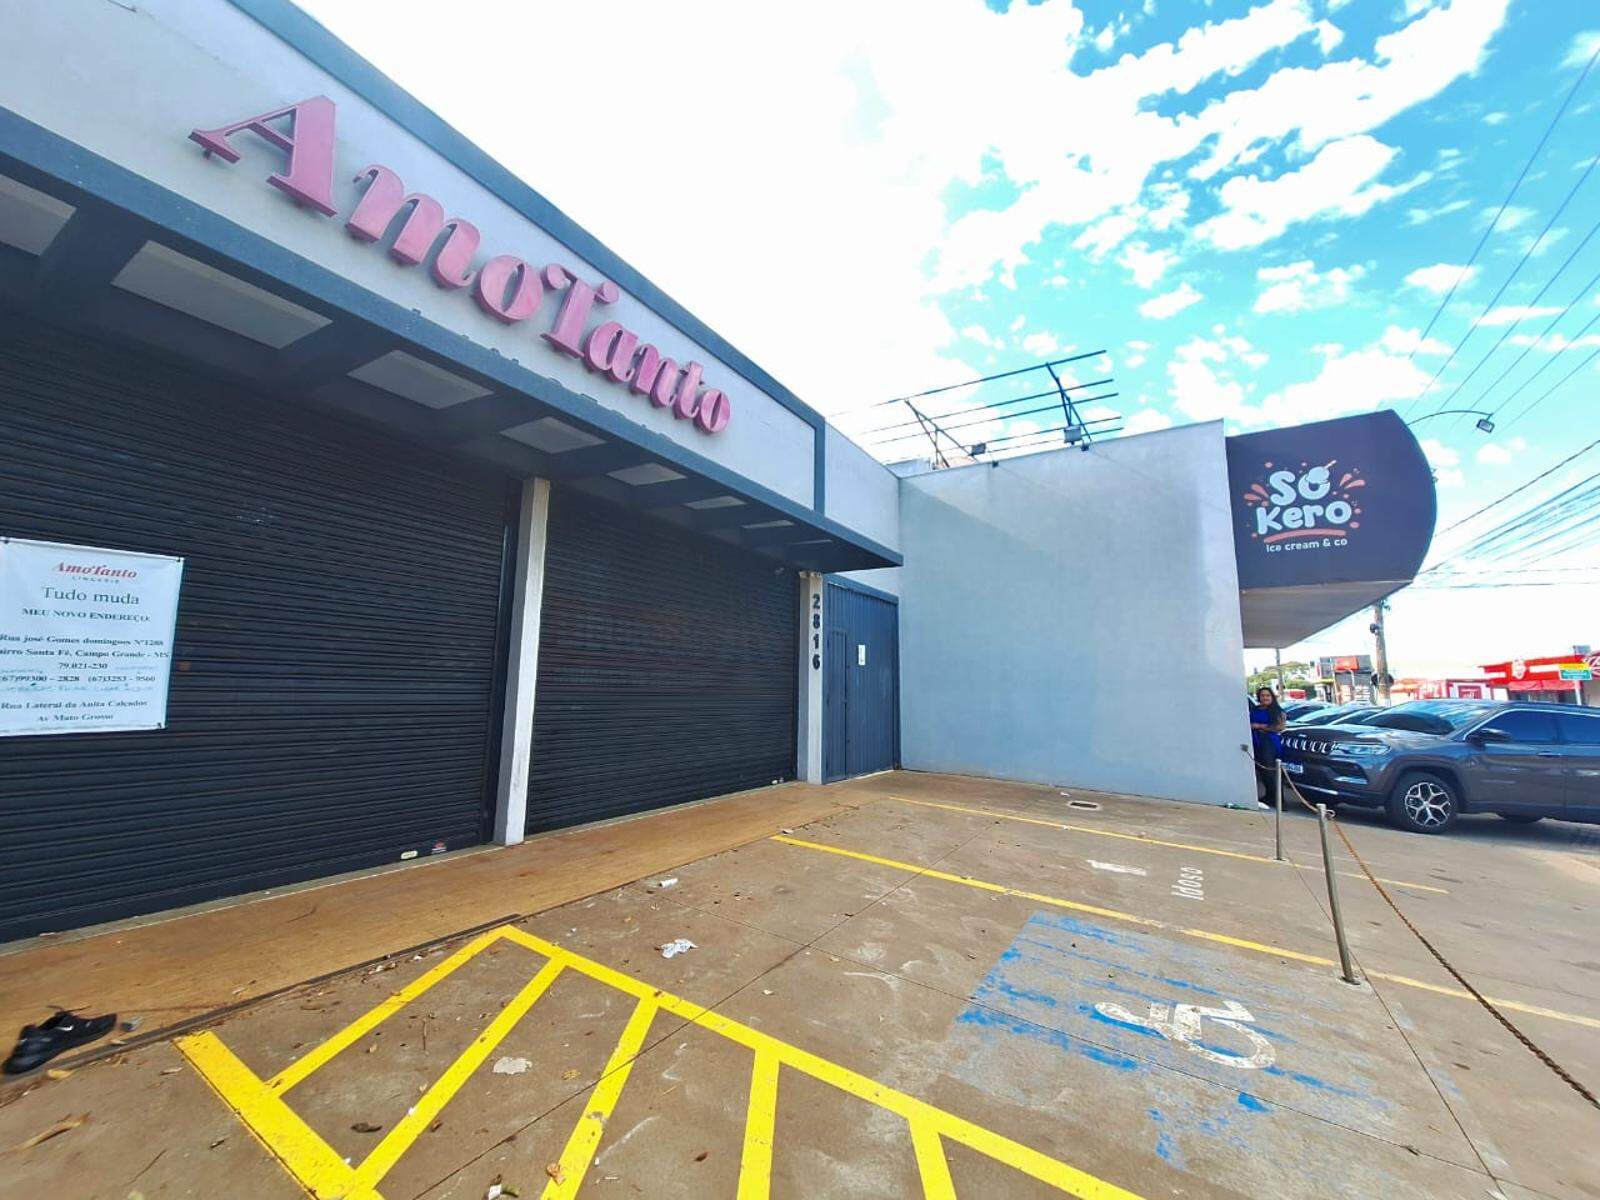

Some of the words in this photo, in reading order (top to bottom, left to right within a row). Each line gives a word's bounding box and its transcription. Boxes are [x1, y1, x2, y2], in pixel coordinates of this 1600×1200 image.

[1284, 540, 1320, 551] cream
[1322, 538, 1331, 547] &
[1334, 538, 1348, 546] co
[42, 586, 87, 601] Tudo
[93, 593, 140, 605] muda
[53, 610, 87, 618] NOVO
[811, 593, 822, 671] 2816
